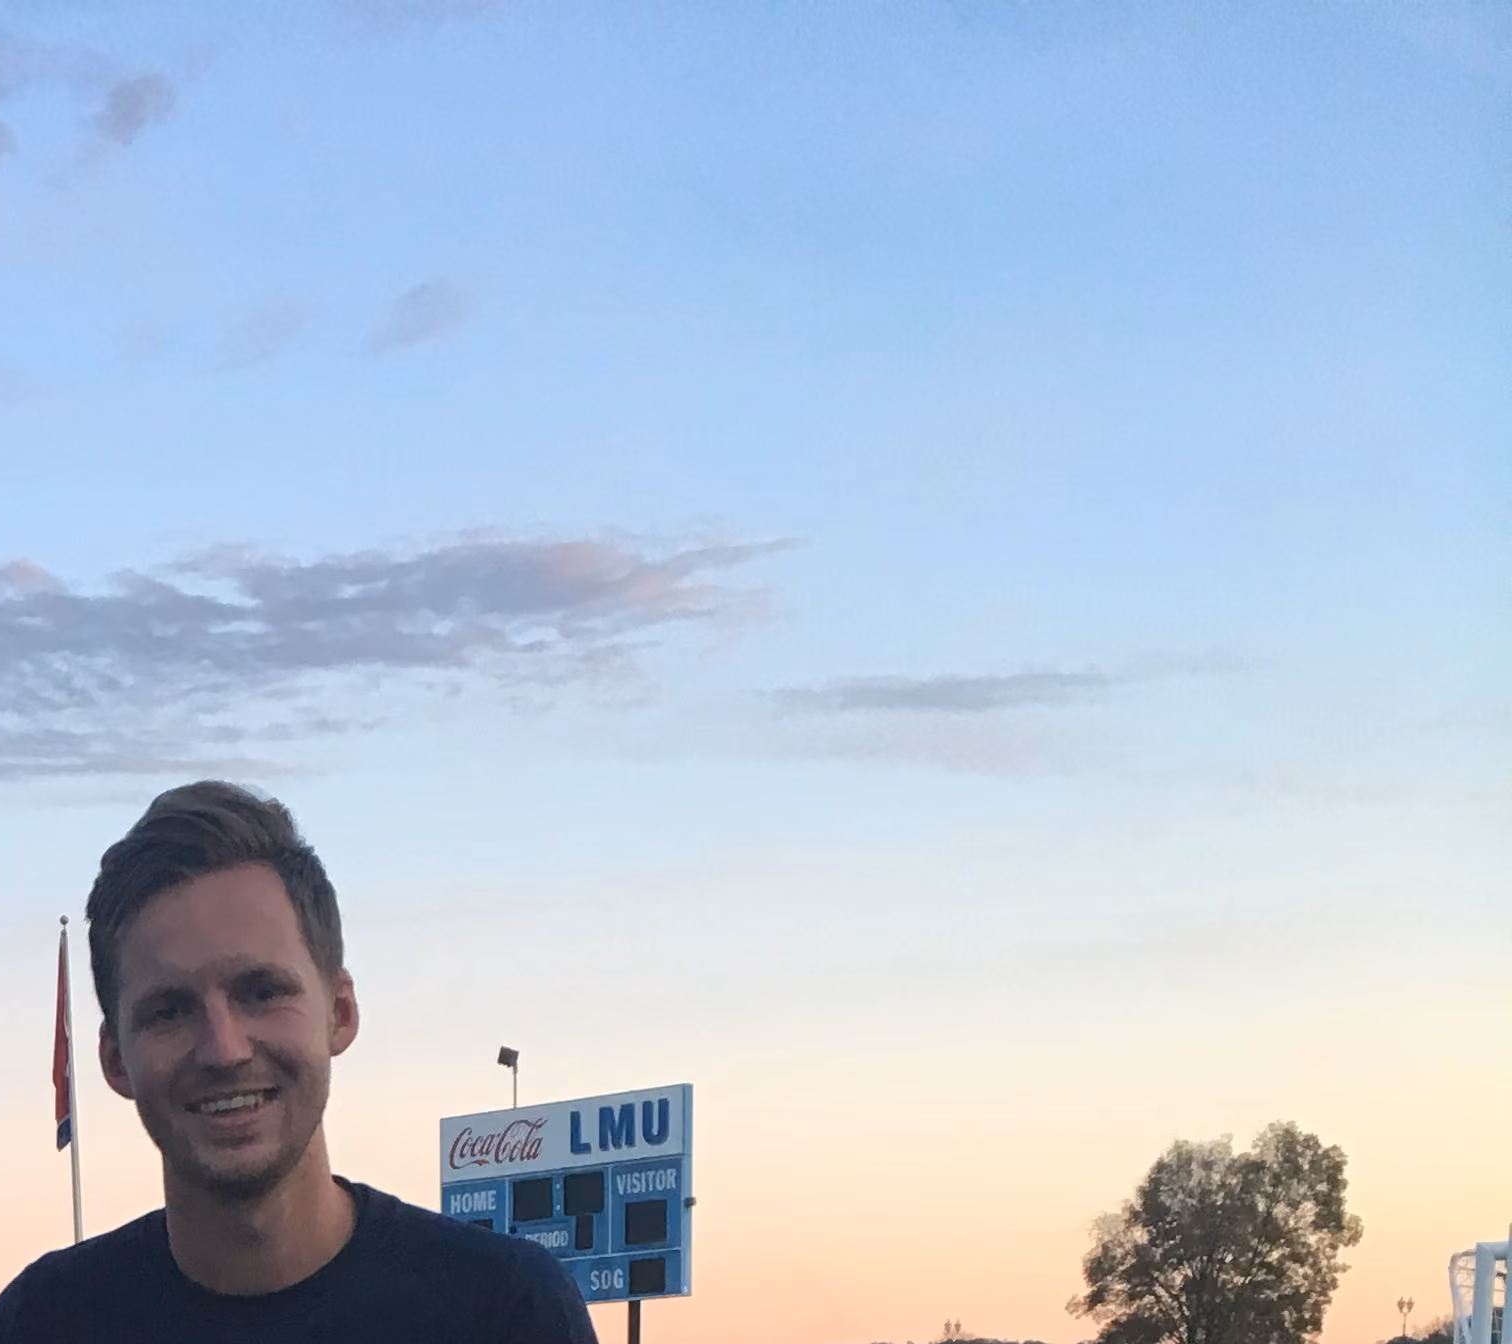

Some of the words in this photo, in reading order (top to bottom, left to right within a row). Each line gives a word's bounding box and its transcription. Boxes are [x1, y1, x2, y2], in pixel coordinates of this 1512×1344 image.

[570, 1098, 670, 1155] LMU
[449, 1117, 548, 1170] Coca-Cola
[616, 1168, 677, 1196] VISITOR
[450, 1190, 497, 1215] HOME
[590, 1268, 624, 1291] SOG
